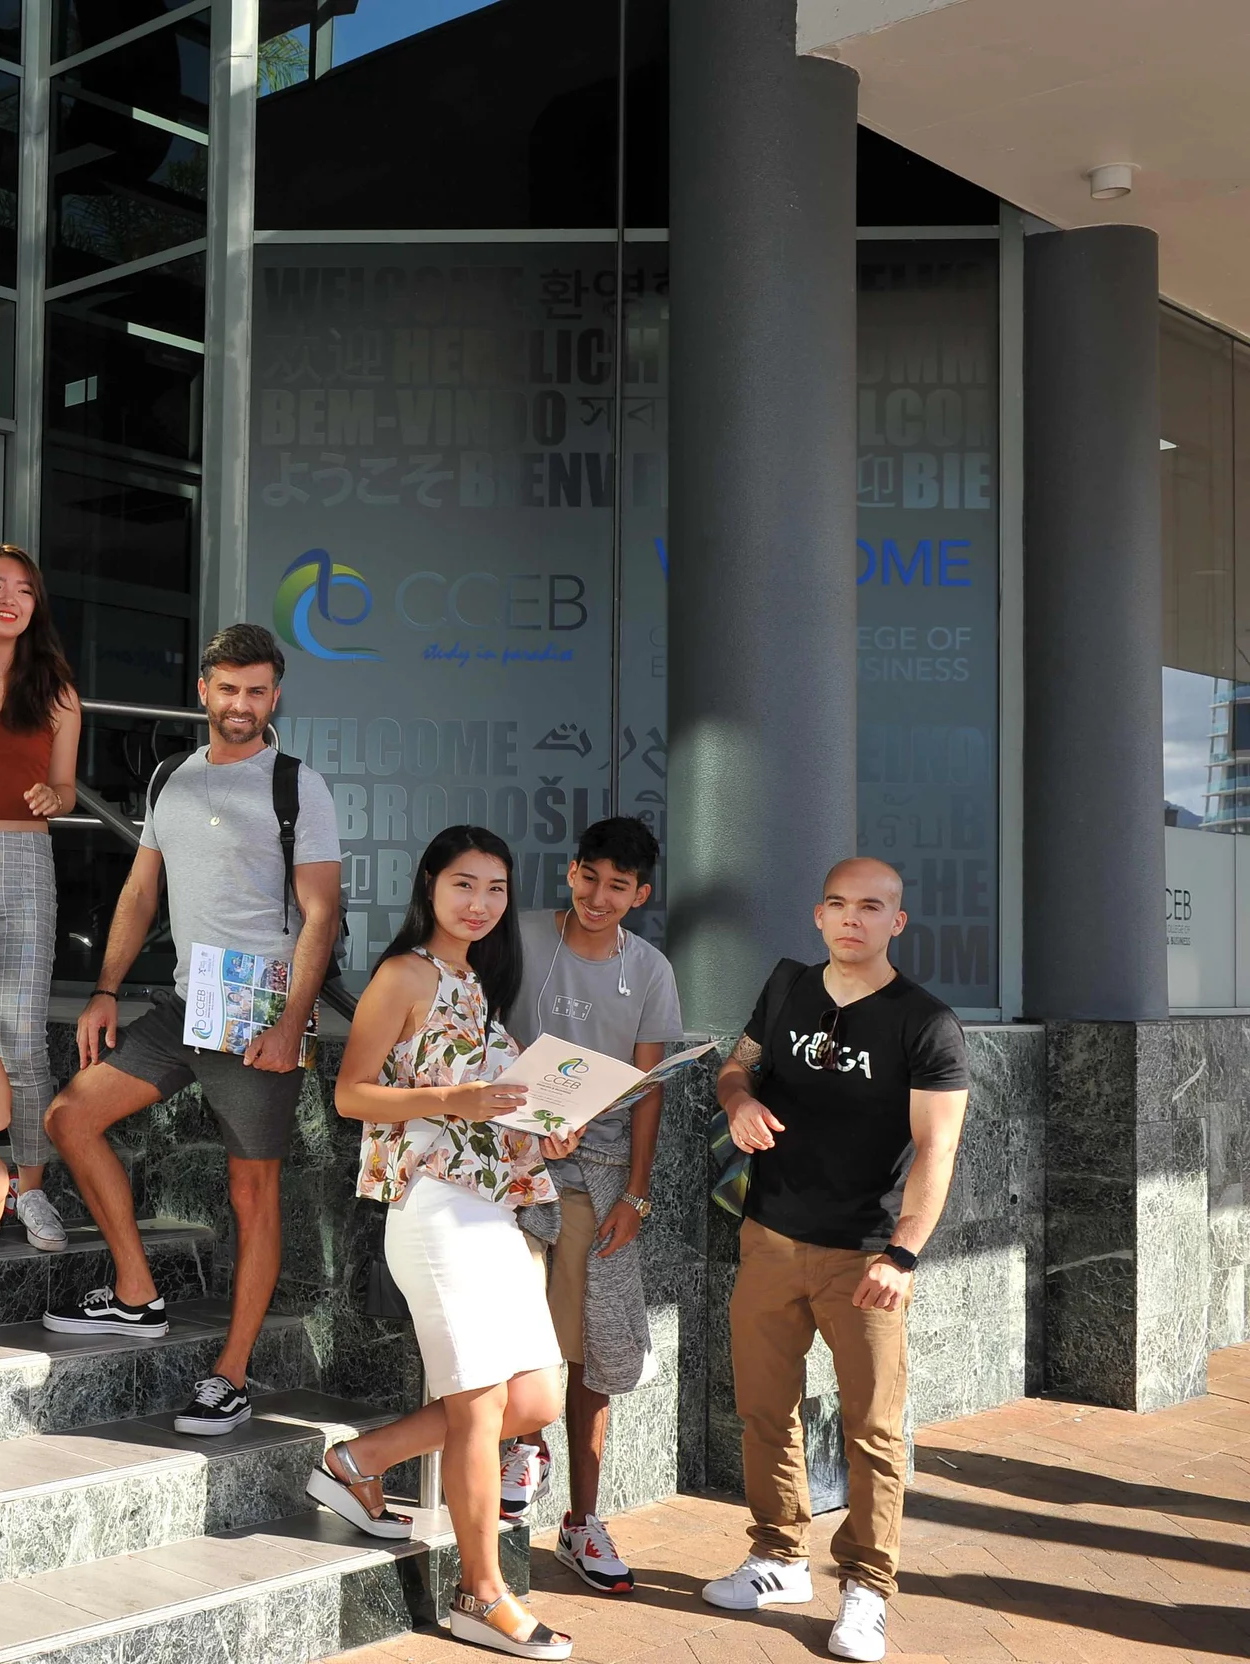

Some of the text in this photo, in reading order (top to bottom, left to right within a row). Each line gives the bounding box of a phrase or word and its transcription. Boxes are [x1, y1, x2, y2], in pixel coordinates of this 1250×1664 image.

[261, 389, 567, 447] BEM-VINDO
[262, 452, 455, 508] ようこそ
[394, 571, 589, 632] CCEB
[927, 626, 972, 651] OF
[857, 656, 970, 682] SINESS
[543, 1074, 582, 1090] CCEB
